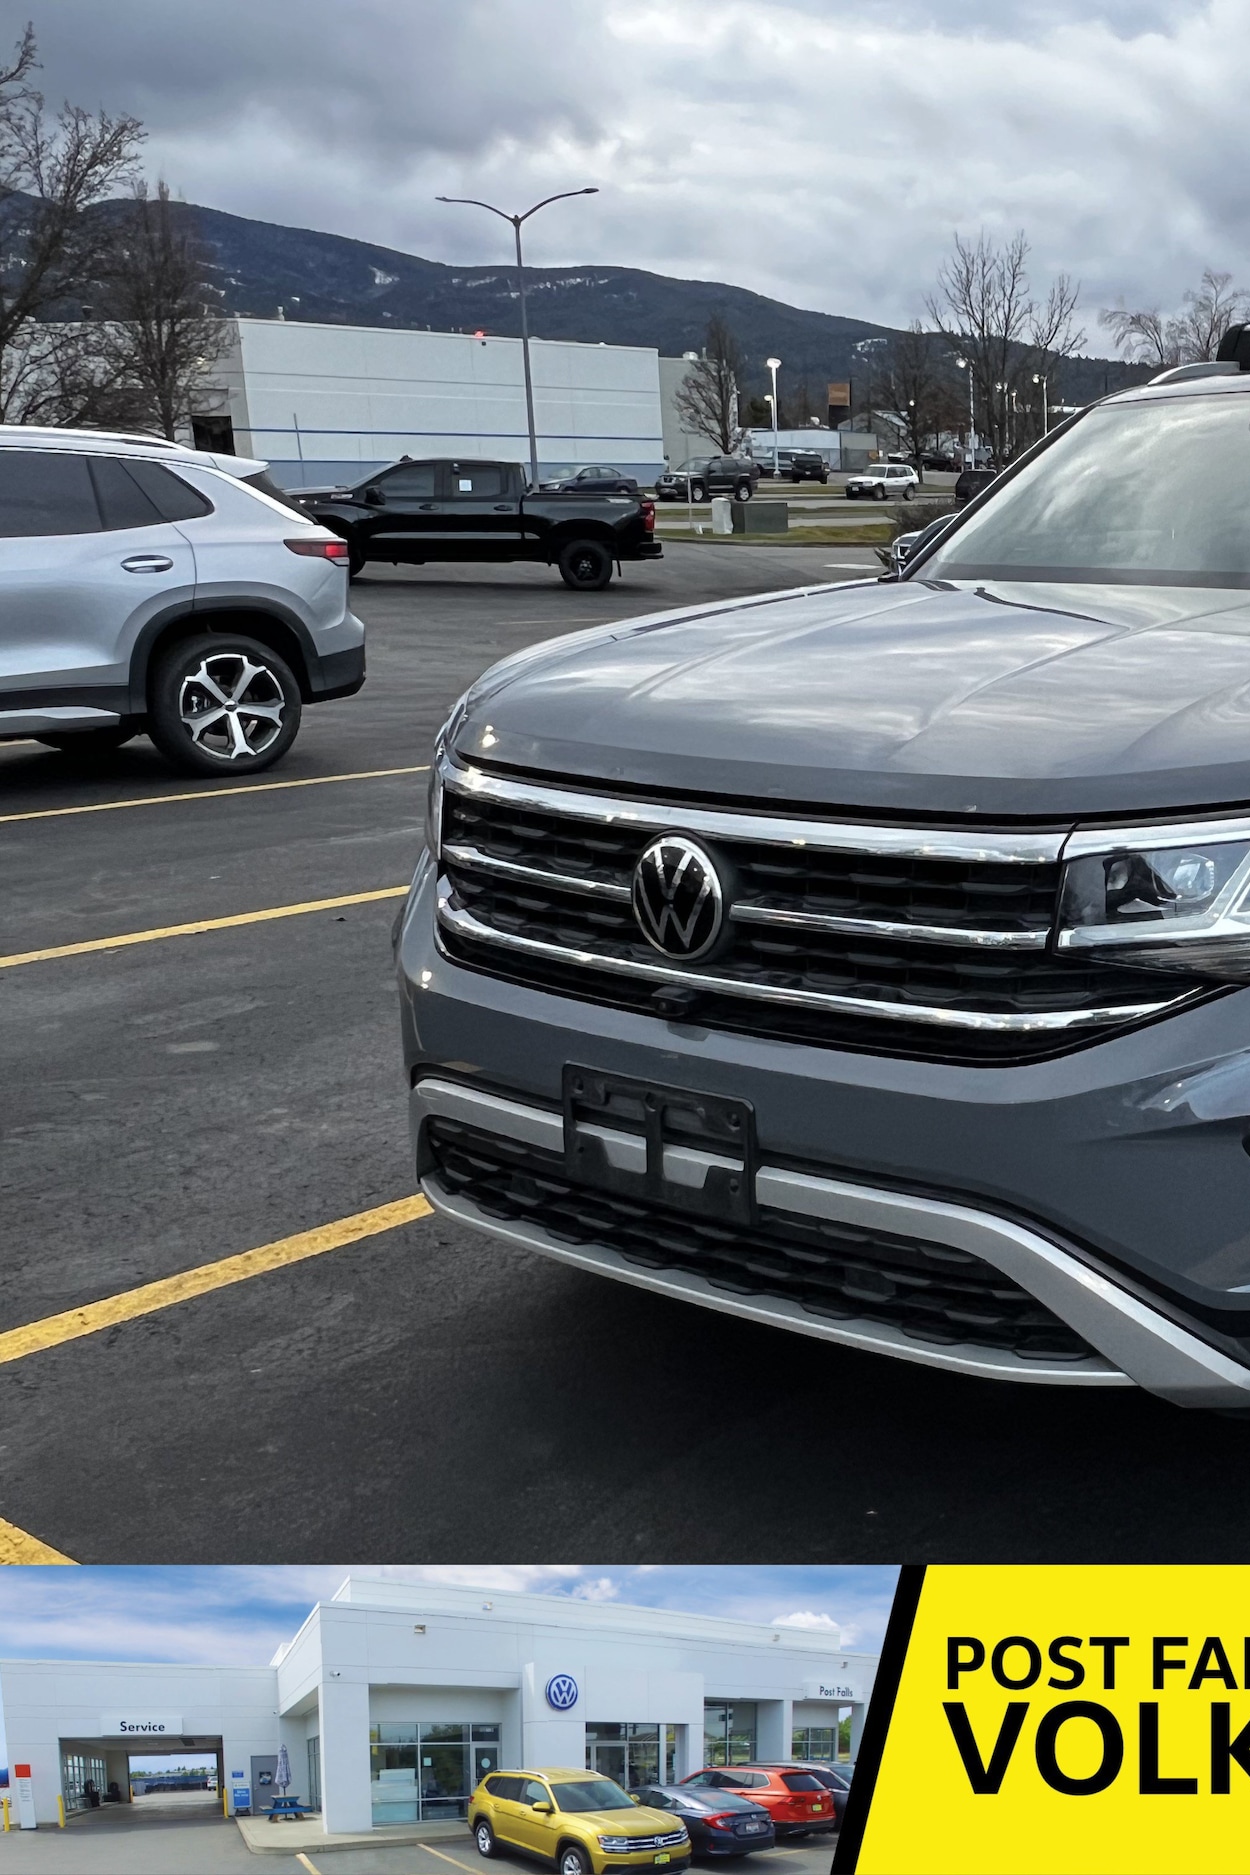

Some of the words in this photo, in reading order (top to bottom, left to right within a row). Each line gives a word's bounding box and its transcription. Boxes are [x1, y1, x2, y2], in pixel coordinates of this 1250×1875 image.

[819, 1685, 835, 1697] Post
[836, 1686, 854, 1698] Falls
[119, 1720, 166, 1732] Service
